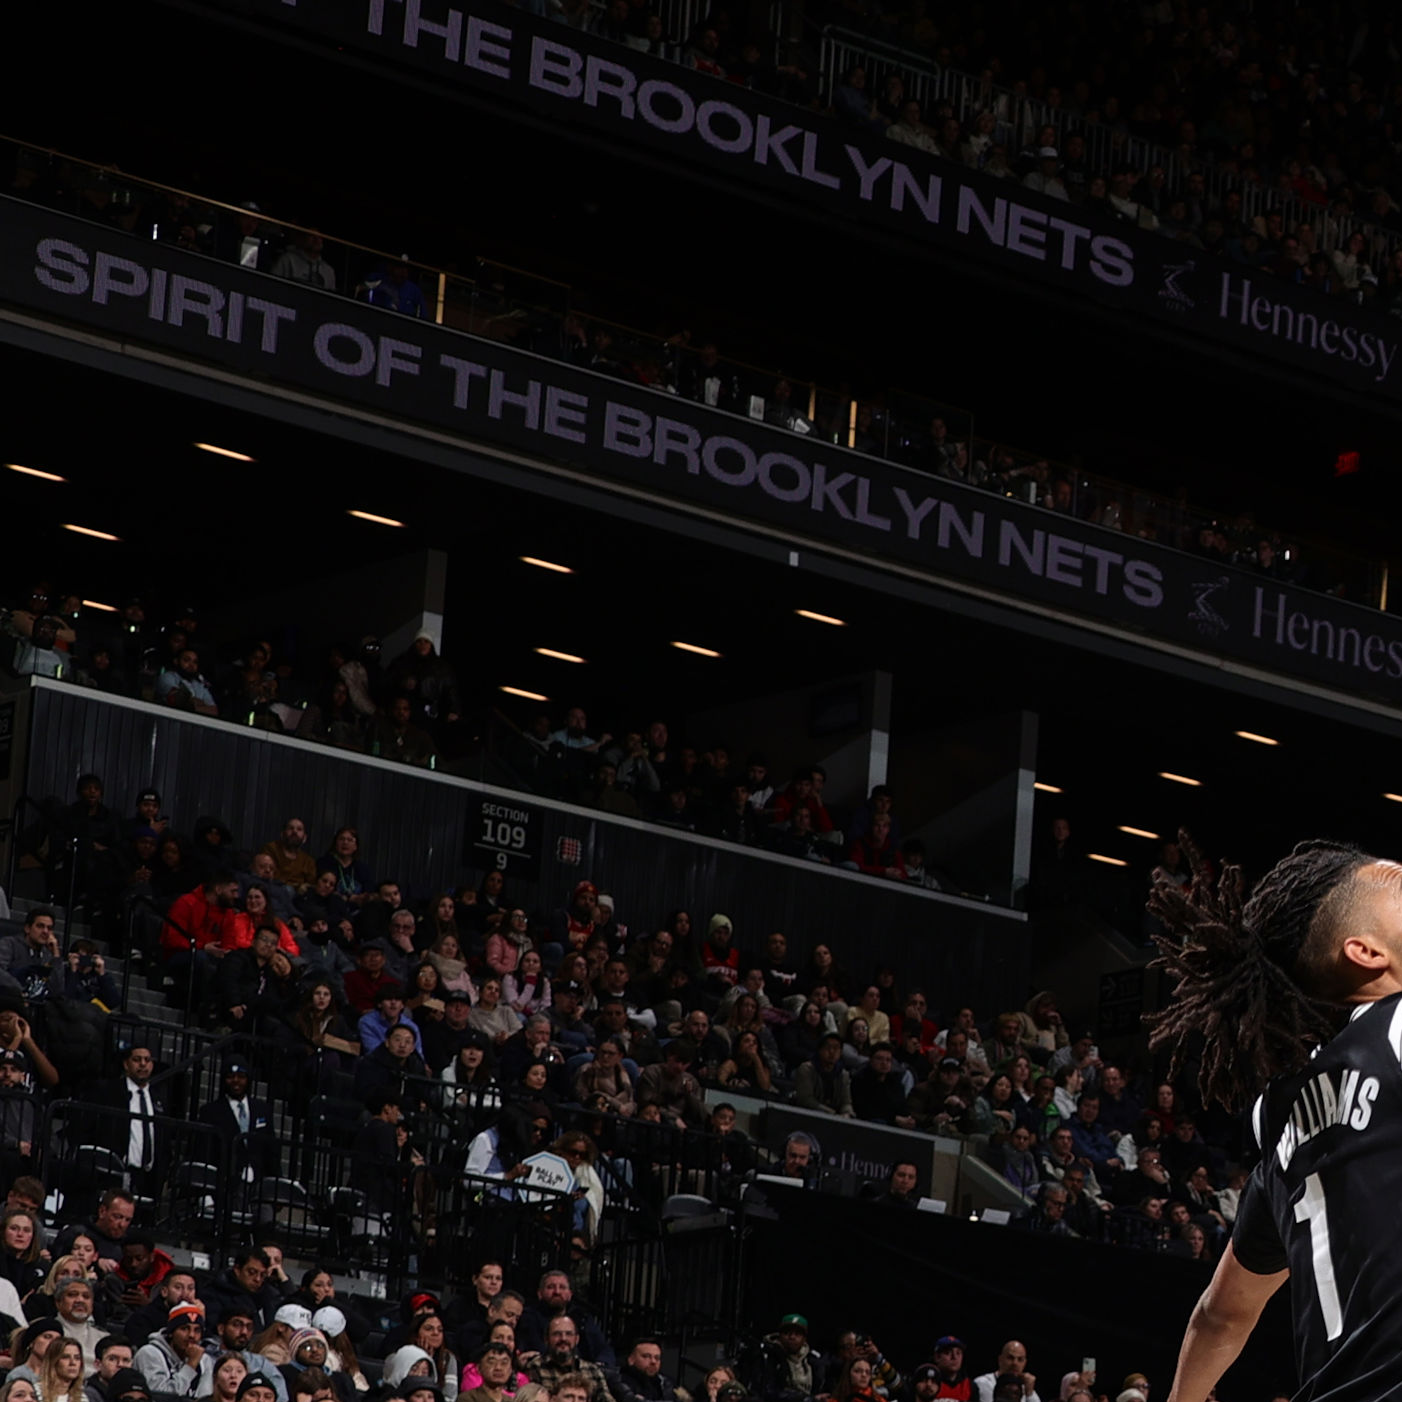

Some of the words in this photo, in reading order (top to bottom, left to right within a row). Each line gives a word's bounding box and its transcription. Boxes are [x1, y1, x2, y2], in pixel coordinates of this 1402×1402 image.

[528, 35, 943, 225] BROOKLYN
[956, 184, 1136, 287] NETS
[1219, 271, 1400, 382] Hennessy
[33, 237, 297, 355] SPIRIT
[312, 322, 424, 387] OF
[439, 352, 590, 444] THE
[603, 402, 985, 558] BROOKLYN
[997, 520, 1165, 609] NETS
[482, 803, 529, 825] SECTION
[482, 819, 526, 849] 109
[496, 853, 508, 872] 9
[1294, 1172, 1343, 1342] 1
